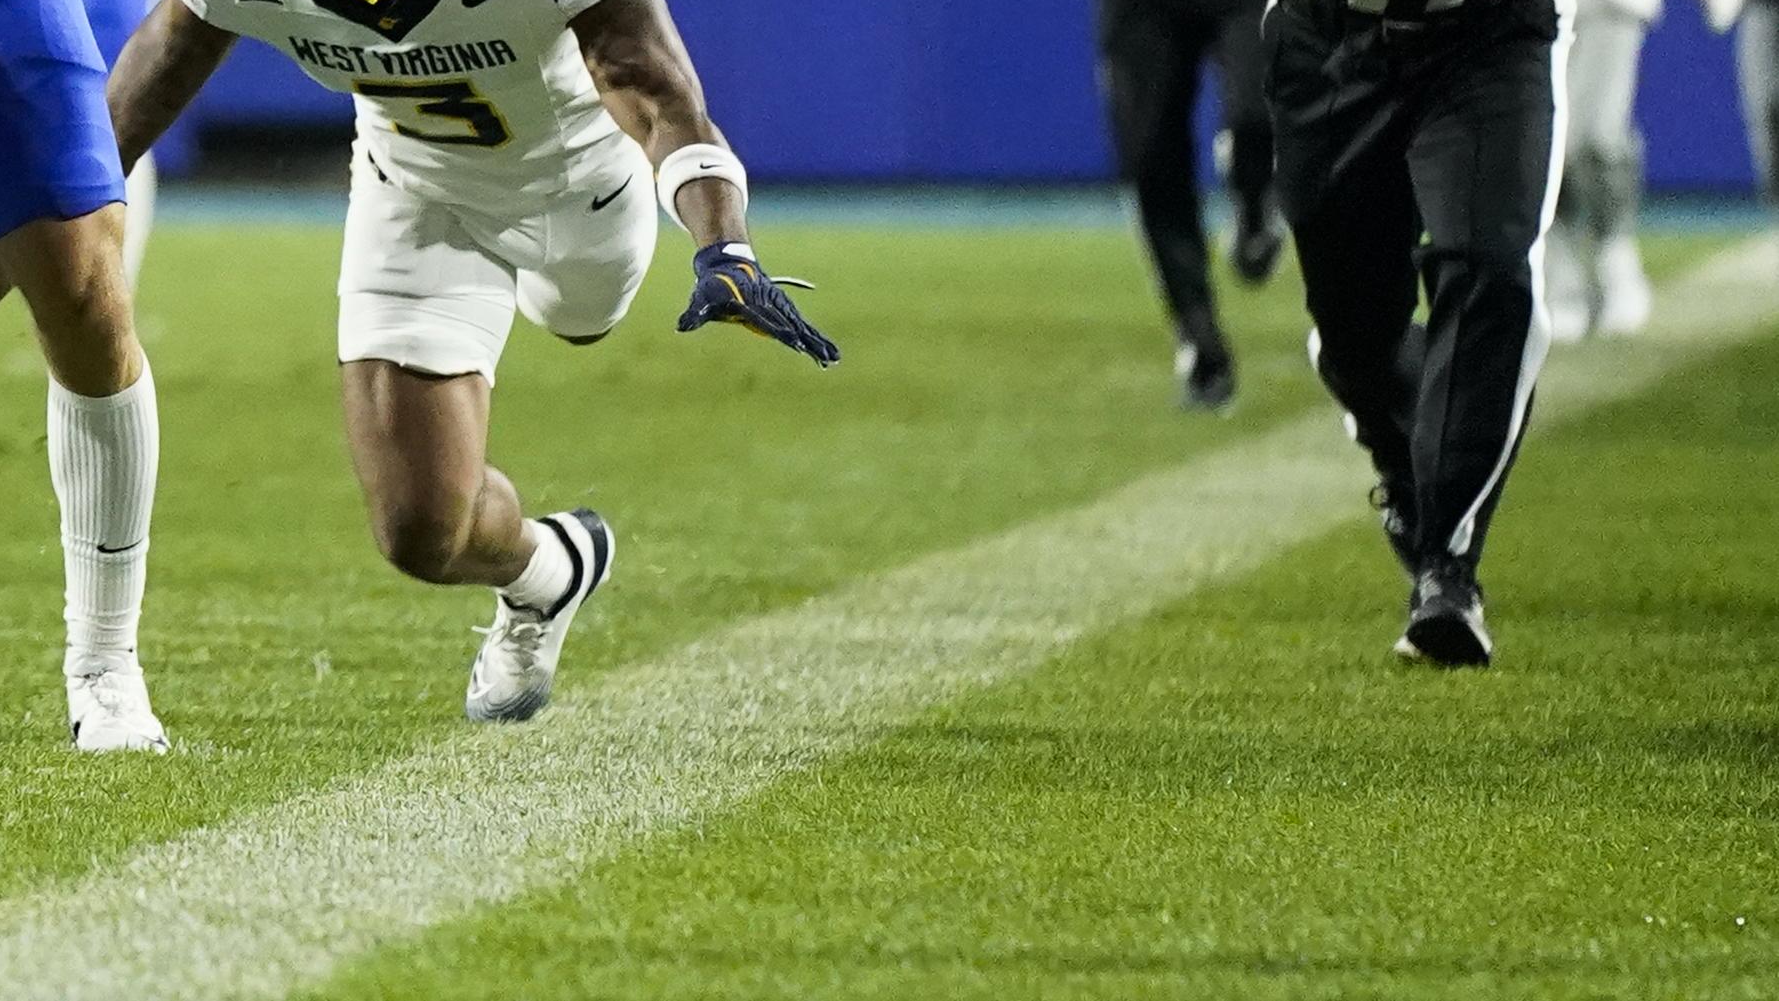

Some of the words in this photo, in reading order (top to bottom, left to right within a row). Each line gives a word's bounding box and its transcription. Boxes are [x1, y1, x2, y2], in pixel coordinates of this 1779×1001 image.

[288, 35, 369, 74] WEST
[370, 38, 518, 76] VIRGINIA
[351, 77, 513, 148] 3
